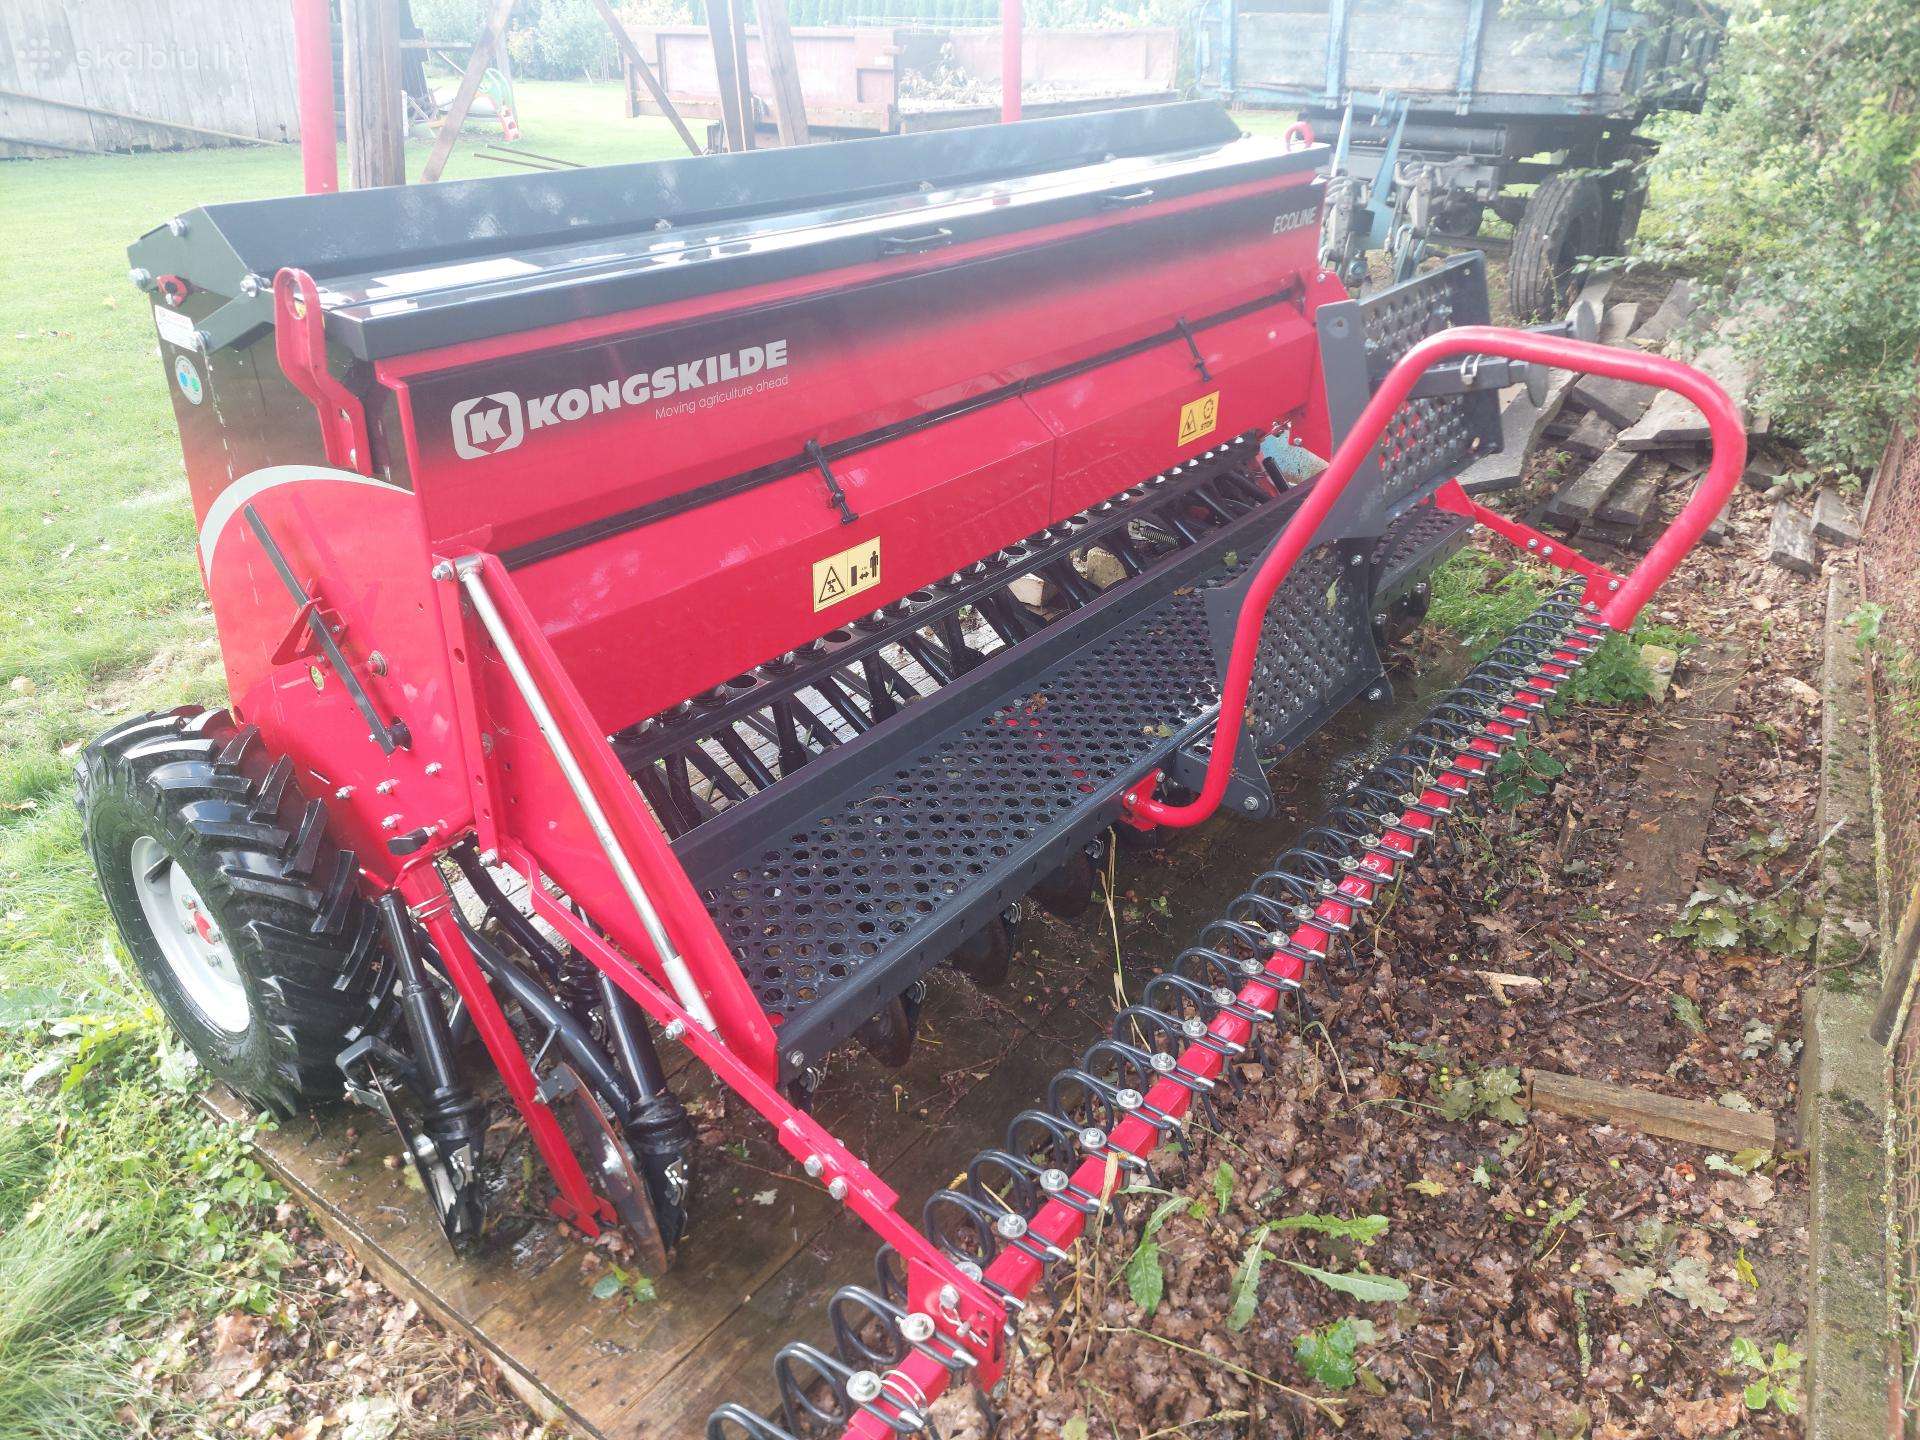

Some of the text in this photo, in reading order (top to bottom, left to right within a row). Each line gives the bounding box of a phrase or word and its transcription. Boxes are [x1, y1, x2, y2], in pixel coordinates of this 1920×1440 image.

[1272, 206, 1317, 234] ECOLINE
[526, 339, 788, 430] KONGSKILDE
[655, 375, 789, 420] Moving agriculture ahead
